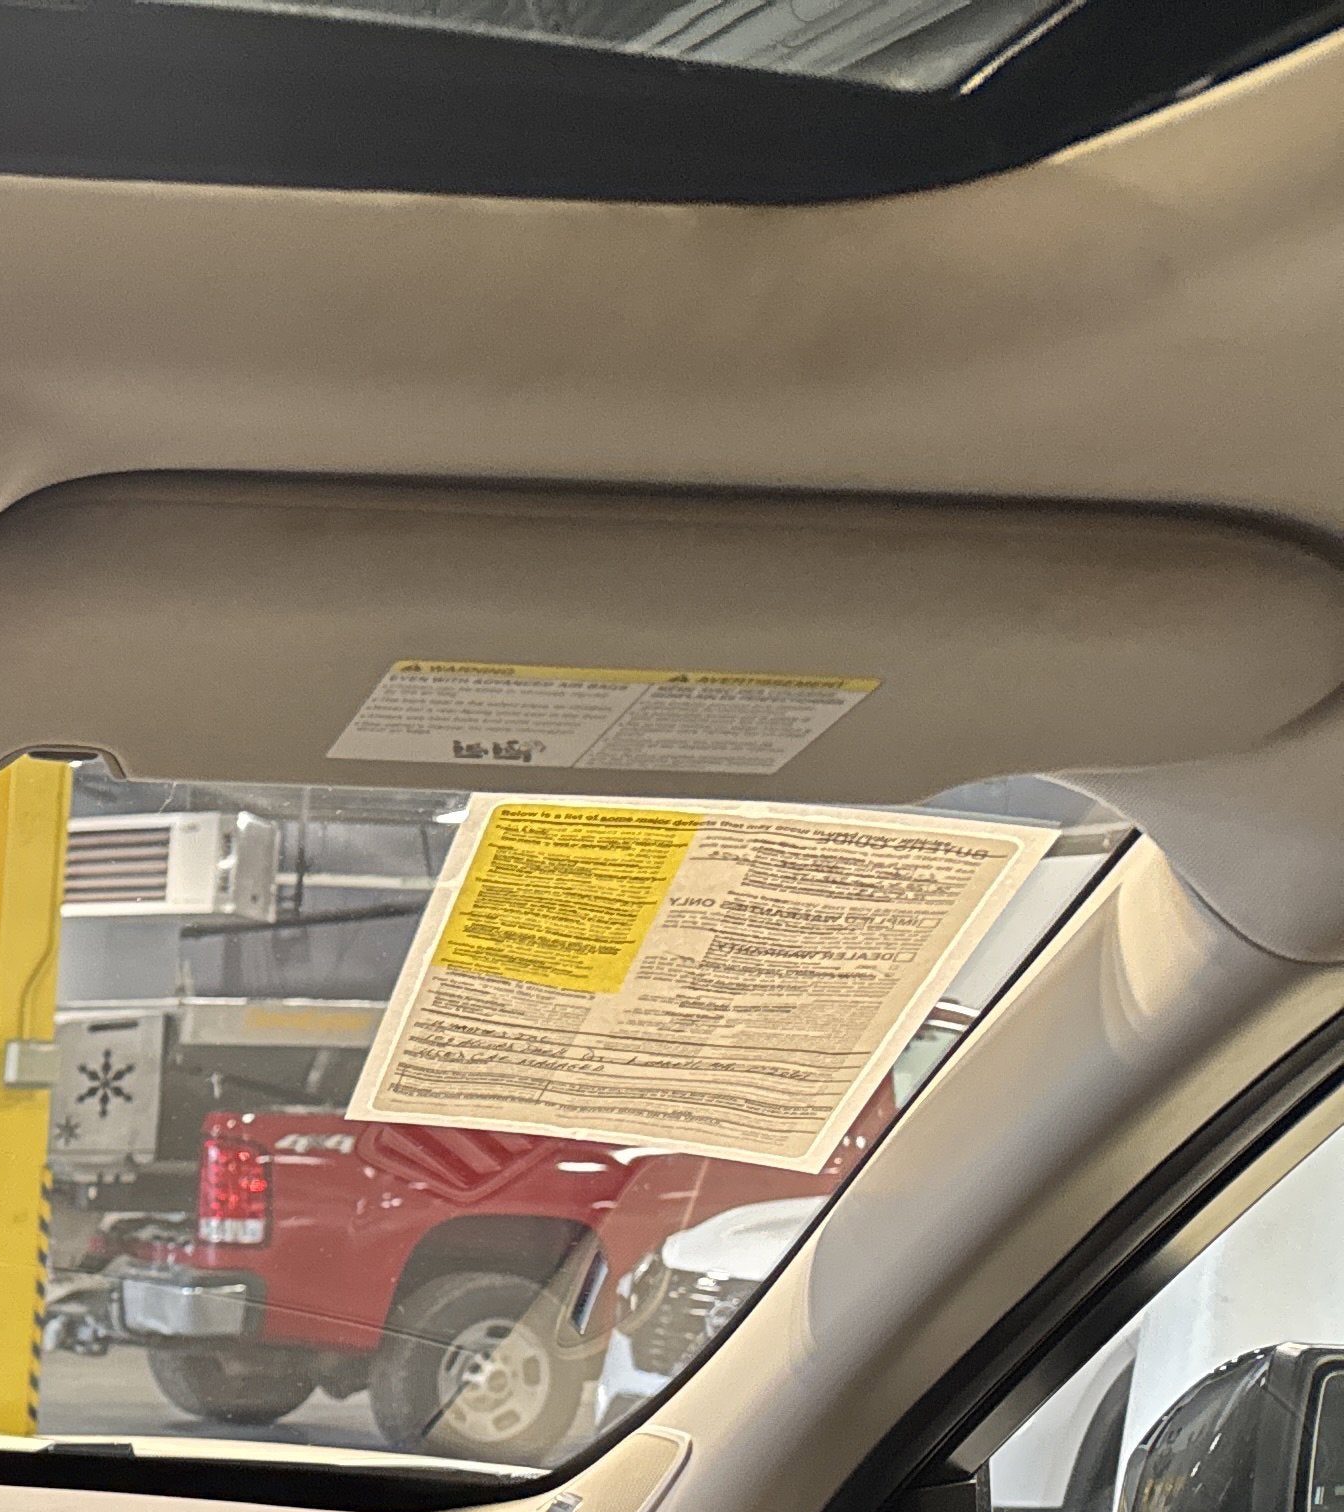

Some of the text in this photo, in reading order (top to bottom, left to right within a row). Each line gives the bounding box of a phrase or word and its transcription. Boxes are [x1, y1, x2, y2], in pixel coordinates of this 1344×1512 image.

[501, 809, 538, 818] Below
[565, 813, 584, 821] list
[673, 818, 718, 827] defects
